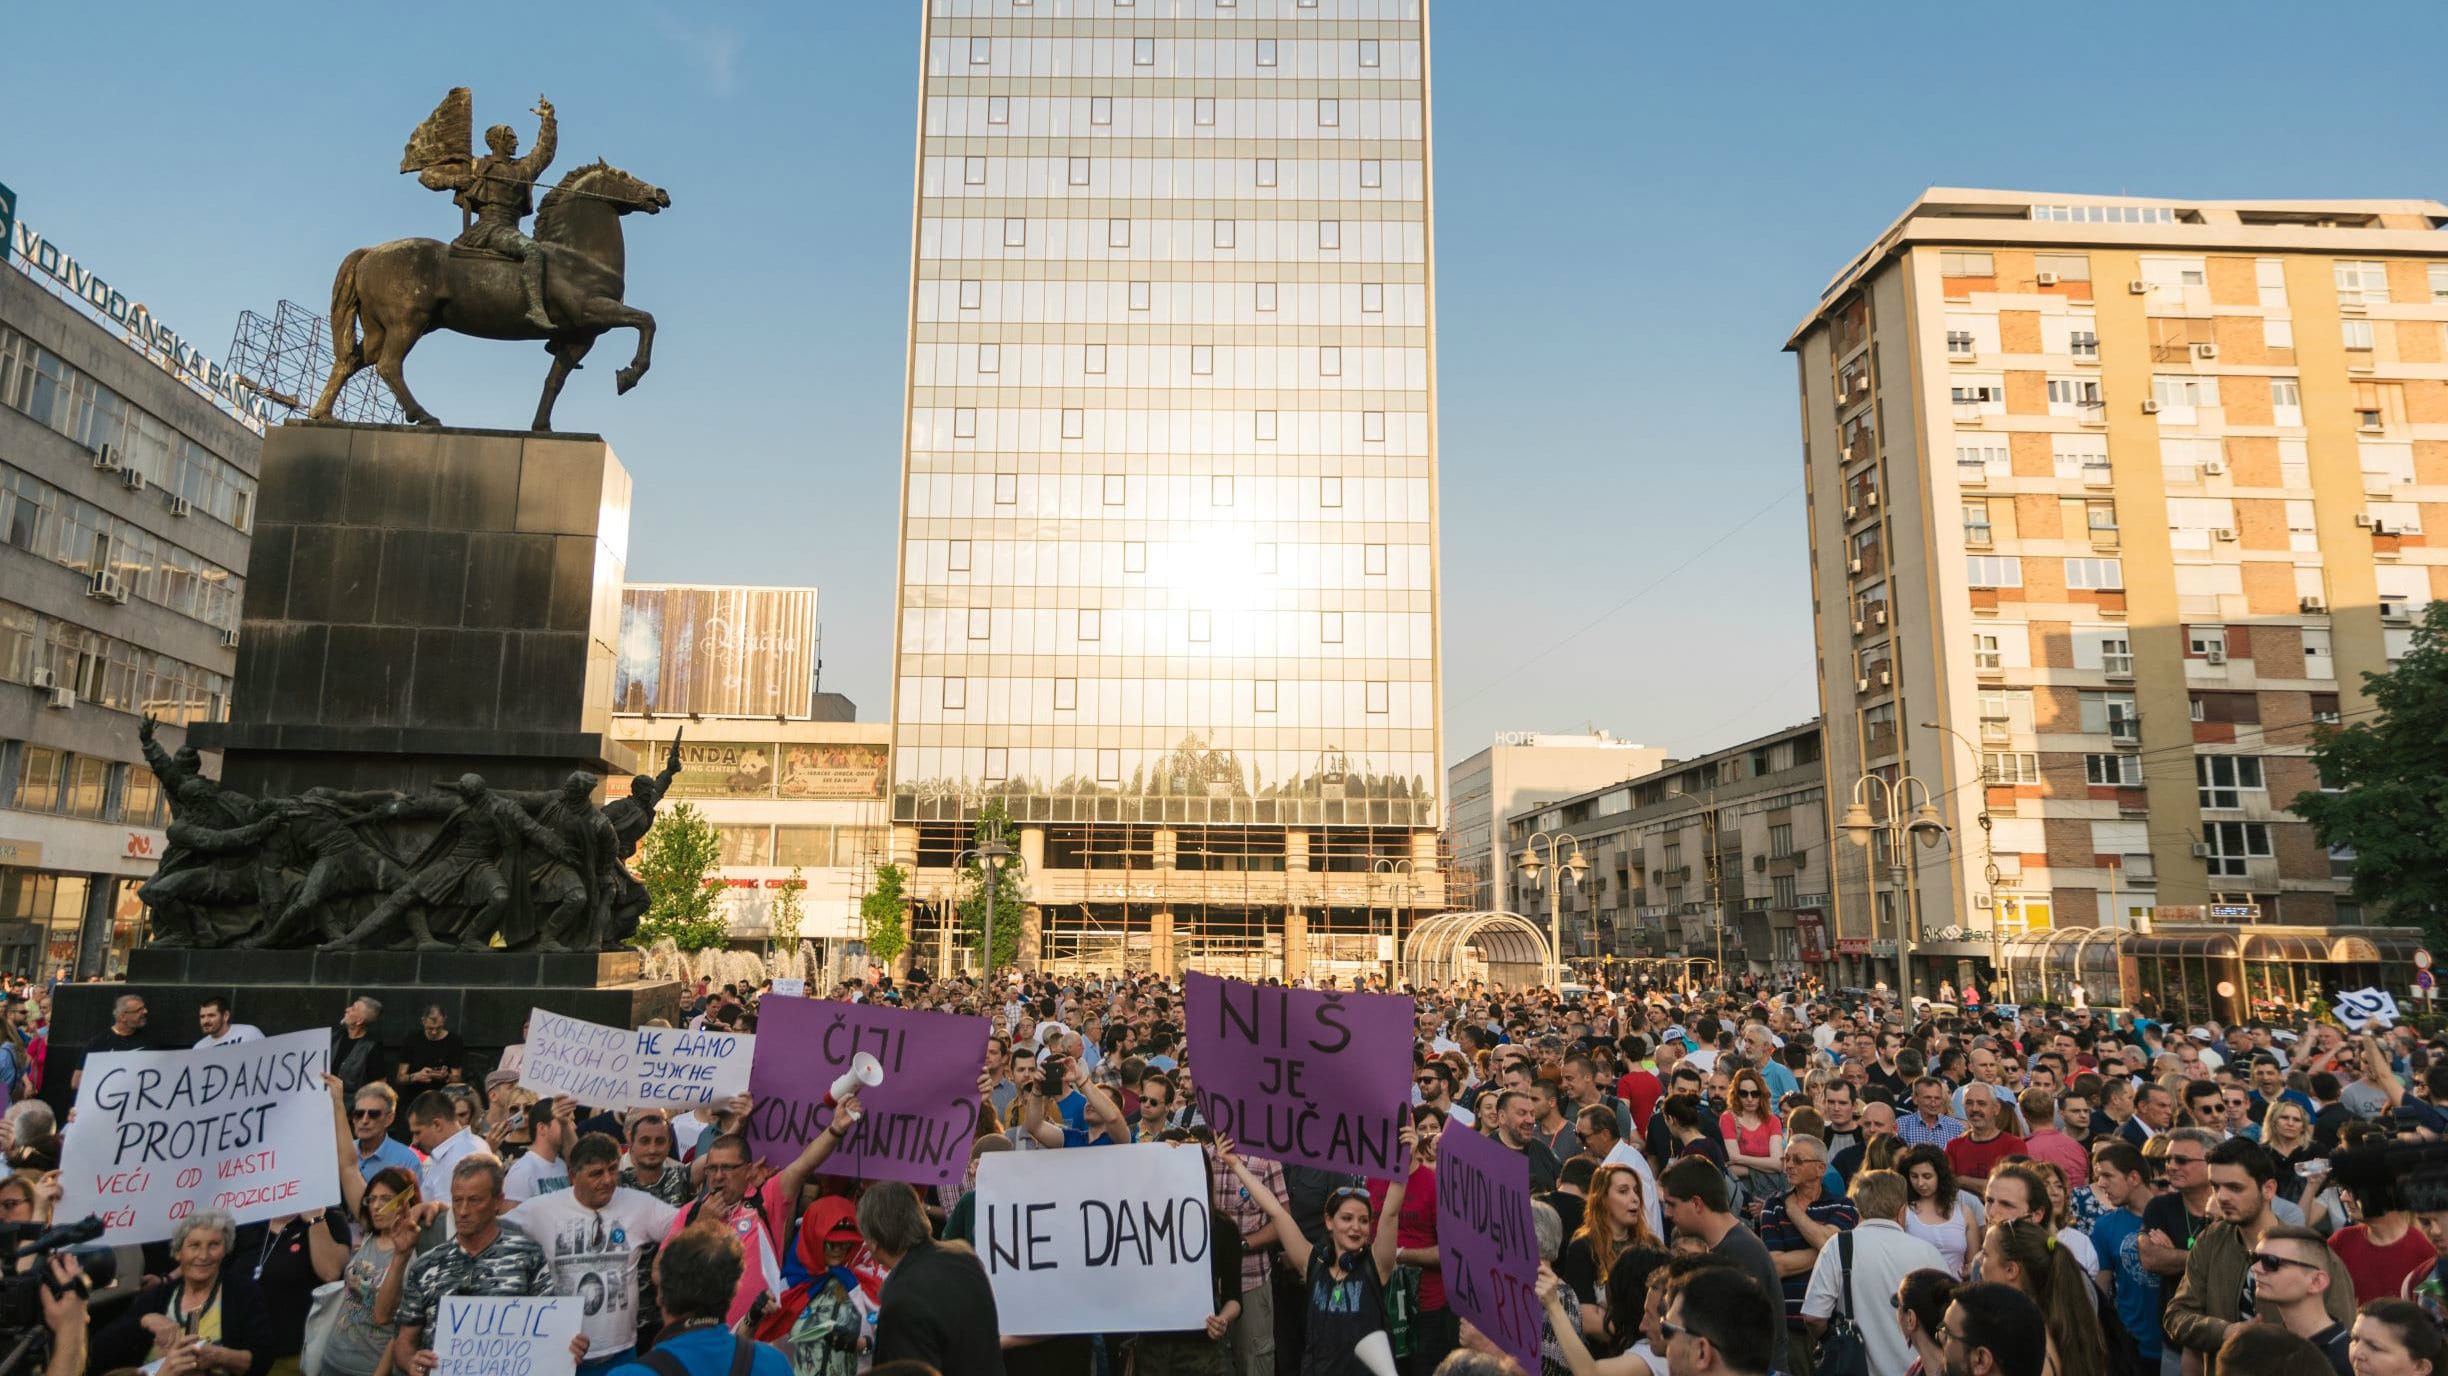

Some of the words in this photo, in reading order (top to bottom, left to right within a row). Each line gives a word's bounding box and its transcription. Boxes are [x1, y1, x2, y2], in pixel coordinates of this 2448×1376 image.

[208, 360, 269, 422] BANKA
[1219, 982, 1352, 1053] NIŠ
[534, 1038, 604, 1069] ЗАКОН
[636, 1032, 662, 1056] НЕ
[672, 1033, 736, 1058] ДАМО
[823, 1013, 906, 1073] ČIJI
[95, 1049, 329, 1122] GRAĐANSKI
[638, 1061, 718, 1081] ЈУЖНЕ
[1259, 1057, 1306, 1098] JE
[640, 1082, 715, 1104] ВЕСТИ
[113, 1102, 277, 1165] PROTEST
[96, 1166, 150, 1194] VEĆI
[176, 1167, 202, 1188] OD
[217, 1151, 276, 1180] VLASTI
[168, 1200, 195, 1220] OD
[988, 1202, 1058, 1274] NE
[1080, 1197, 1208, 1266] DAMO
[450, 1299, 558, 1338] VUČIĆ
[1451, 1247, 1482, 1313] ZA
[1490, 1267, 1539, 1359] RTS
[440, 1357, 532, 1376] PREVARIO
[450, 1338, 532, 1358] PONOVO
